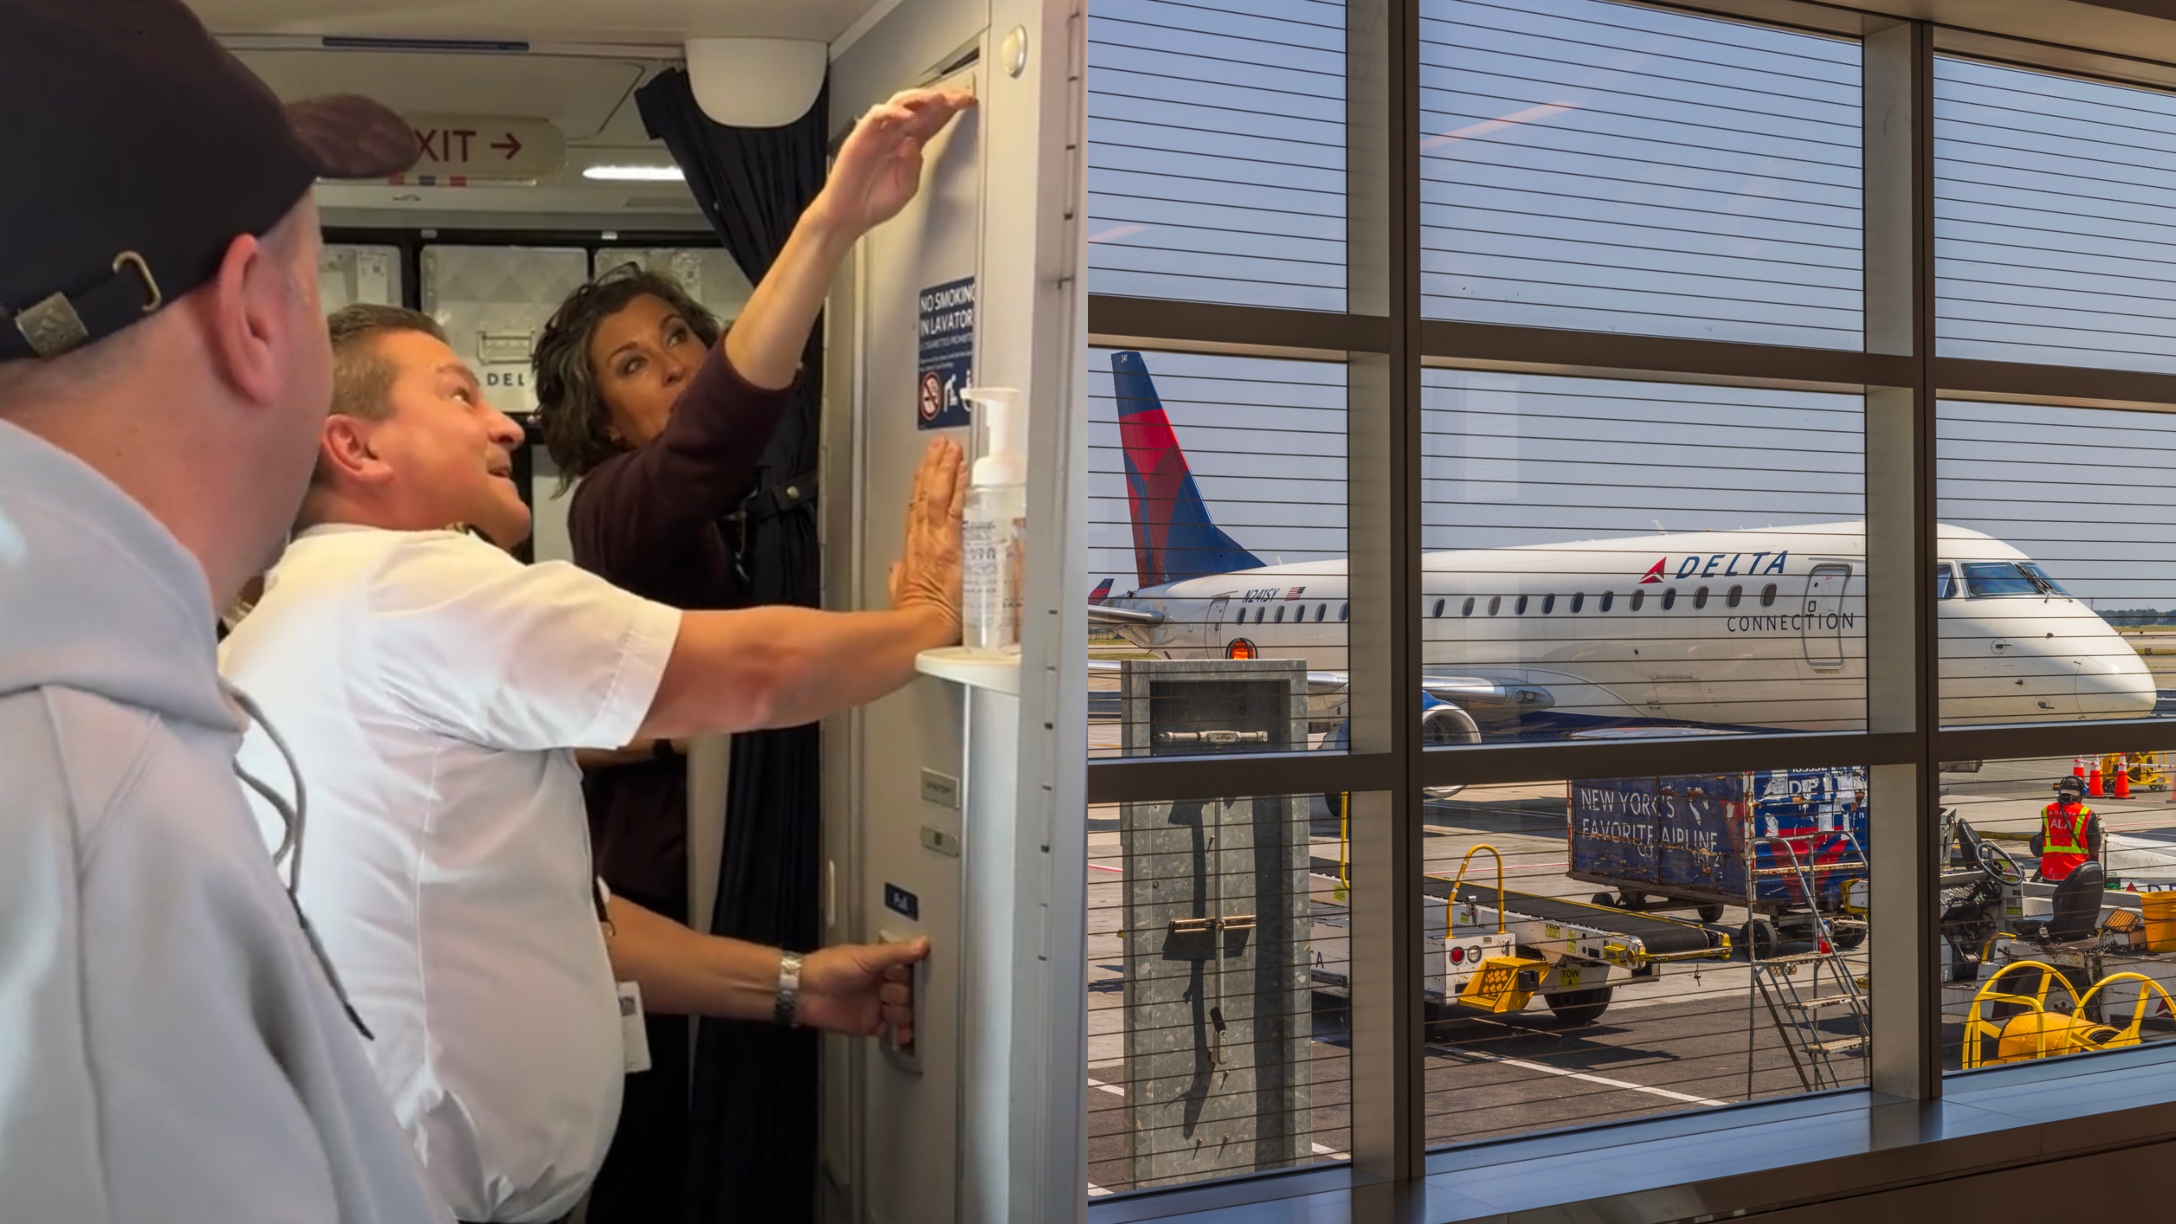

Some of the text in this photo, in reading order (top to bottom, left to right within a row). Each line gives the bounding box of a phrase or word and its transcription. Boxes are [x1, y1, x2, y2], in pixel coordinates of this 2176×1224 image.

[415, 129, 477, 162] XIT
[921, 294, 934, 313] NO
[922, 309, 974, 337] IN LAVATOR
[487, 372, 526, 387] DEL
[1675, 550, 1788, 579] DELTA
[1727, 612, 1854, 633] CONNECTION
[1580, 788, 1675, 819] NEW YORK'S
[1582, 818, 1718, 853] FAVORITE AIRLINE
[1561, 969, 1580, 978] TOW
